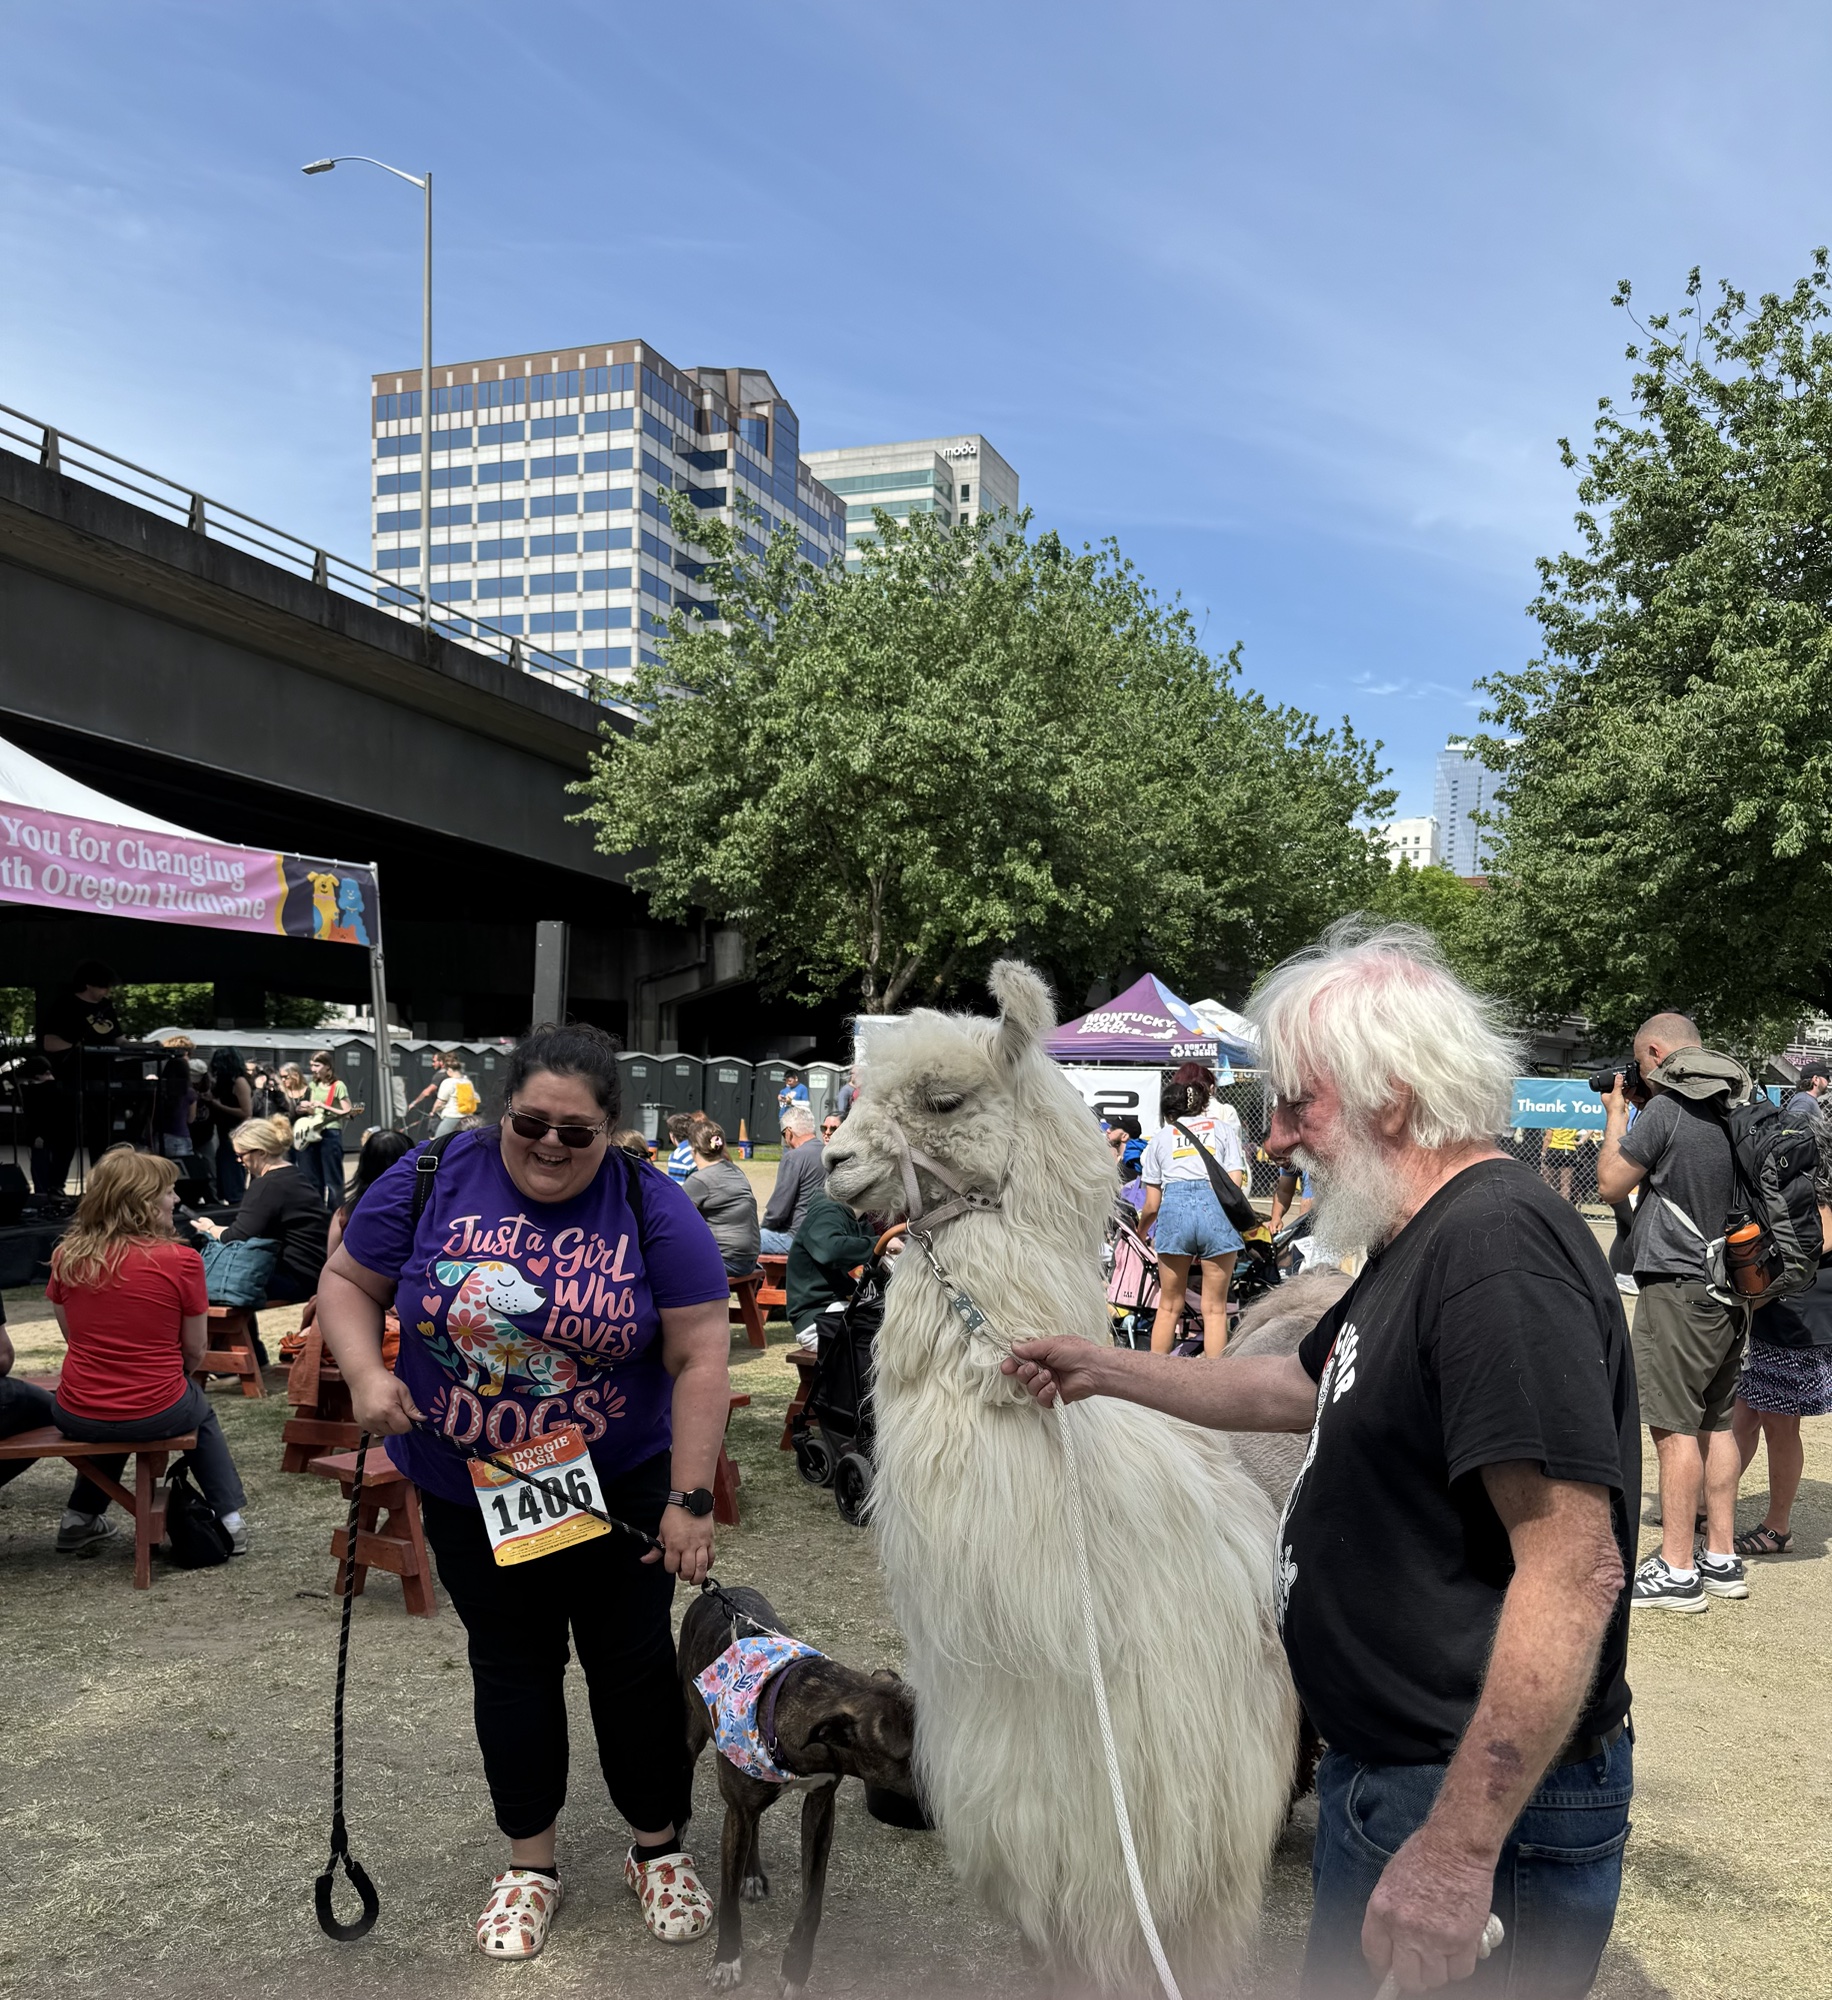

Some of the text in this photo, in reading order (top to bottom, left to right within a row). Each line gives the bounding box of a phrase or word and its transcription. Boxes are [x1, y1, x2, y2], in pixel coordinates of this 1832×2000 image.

[943, 444, 977, 457] moda
[0, 814, 246, 892] You for Changing
[41, 864, 152, 910] Oregon
[155, 882, 266, 920] Humane
[1517, 1098, 1602, 1114] Thank You
[1176, 1132, 1211, 1149] 107
[442, 1213, 546, 1259] Just a
[555, 1272, 635, 1321] Who
[543, 1306, 638, 1357] LOVES
[443, 1385, 607, 1450] DOGS
[511, 1435, 570, 1462] DOGGIE
[515, 1452, 558, 1473] DASH
[491, 1467, 593, 1536] 1406
